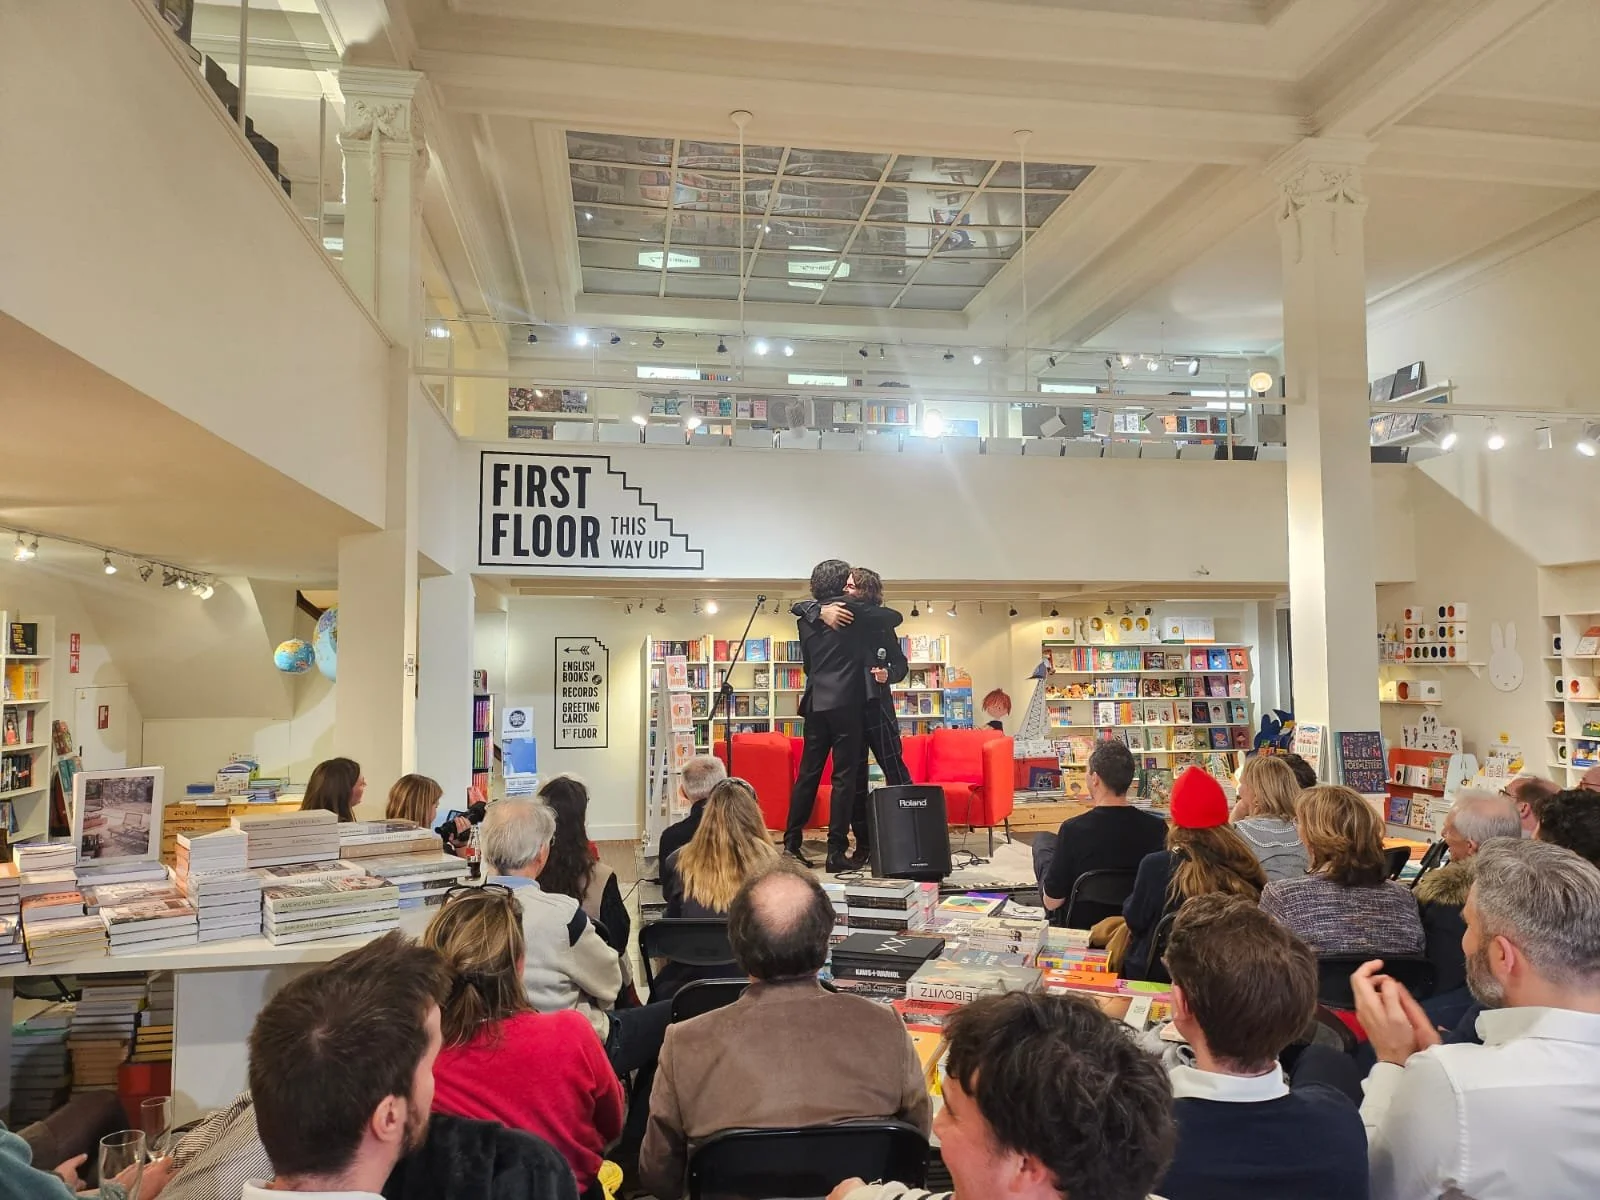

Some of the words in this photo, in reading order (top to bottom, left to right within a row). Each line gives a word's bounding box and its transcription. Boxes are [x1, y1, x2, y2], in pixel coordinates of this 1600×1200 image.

[492, 463, 592, 509] FIRST
[610, 516, 647, 536] THIS
[491, 513, 601, 559] FLOOR
[610, 539, 645, 559] WAY
[648, 540, 670, 560] UP
[563, 661, 595, 671] ENGLISH
[563, 672, 588, 682] BOOKS
[563, 687, 598, 697] RECORDS
[563, 702, 600, 712] GREETING
[563, 713, 588, 723] CARDS
[573, 729, 597, 738] FLOOR
[899, 799, 928, 807] Roland
[280, 900, 311, 910] AMERICAN
[311, 898, 330, 907] ICONS
